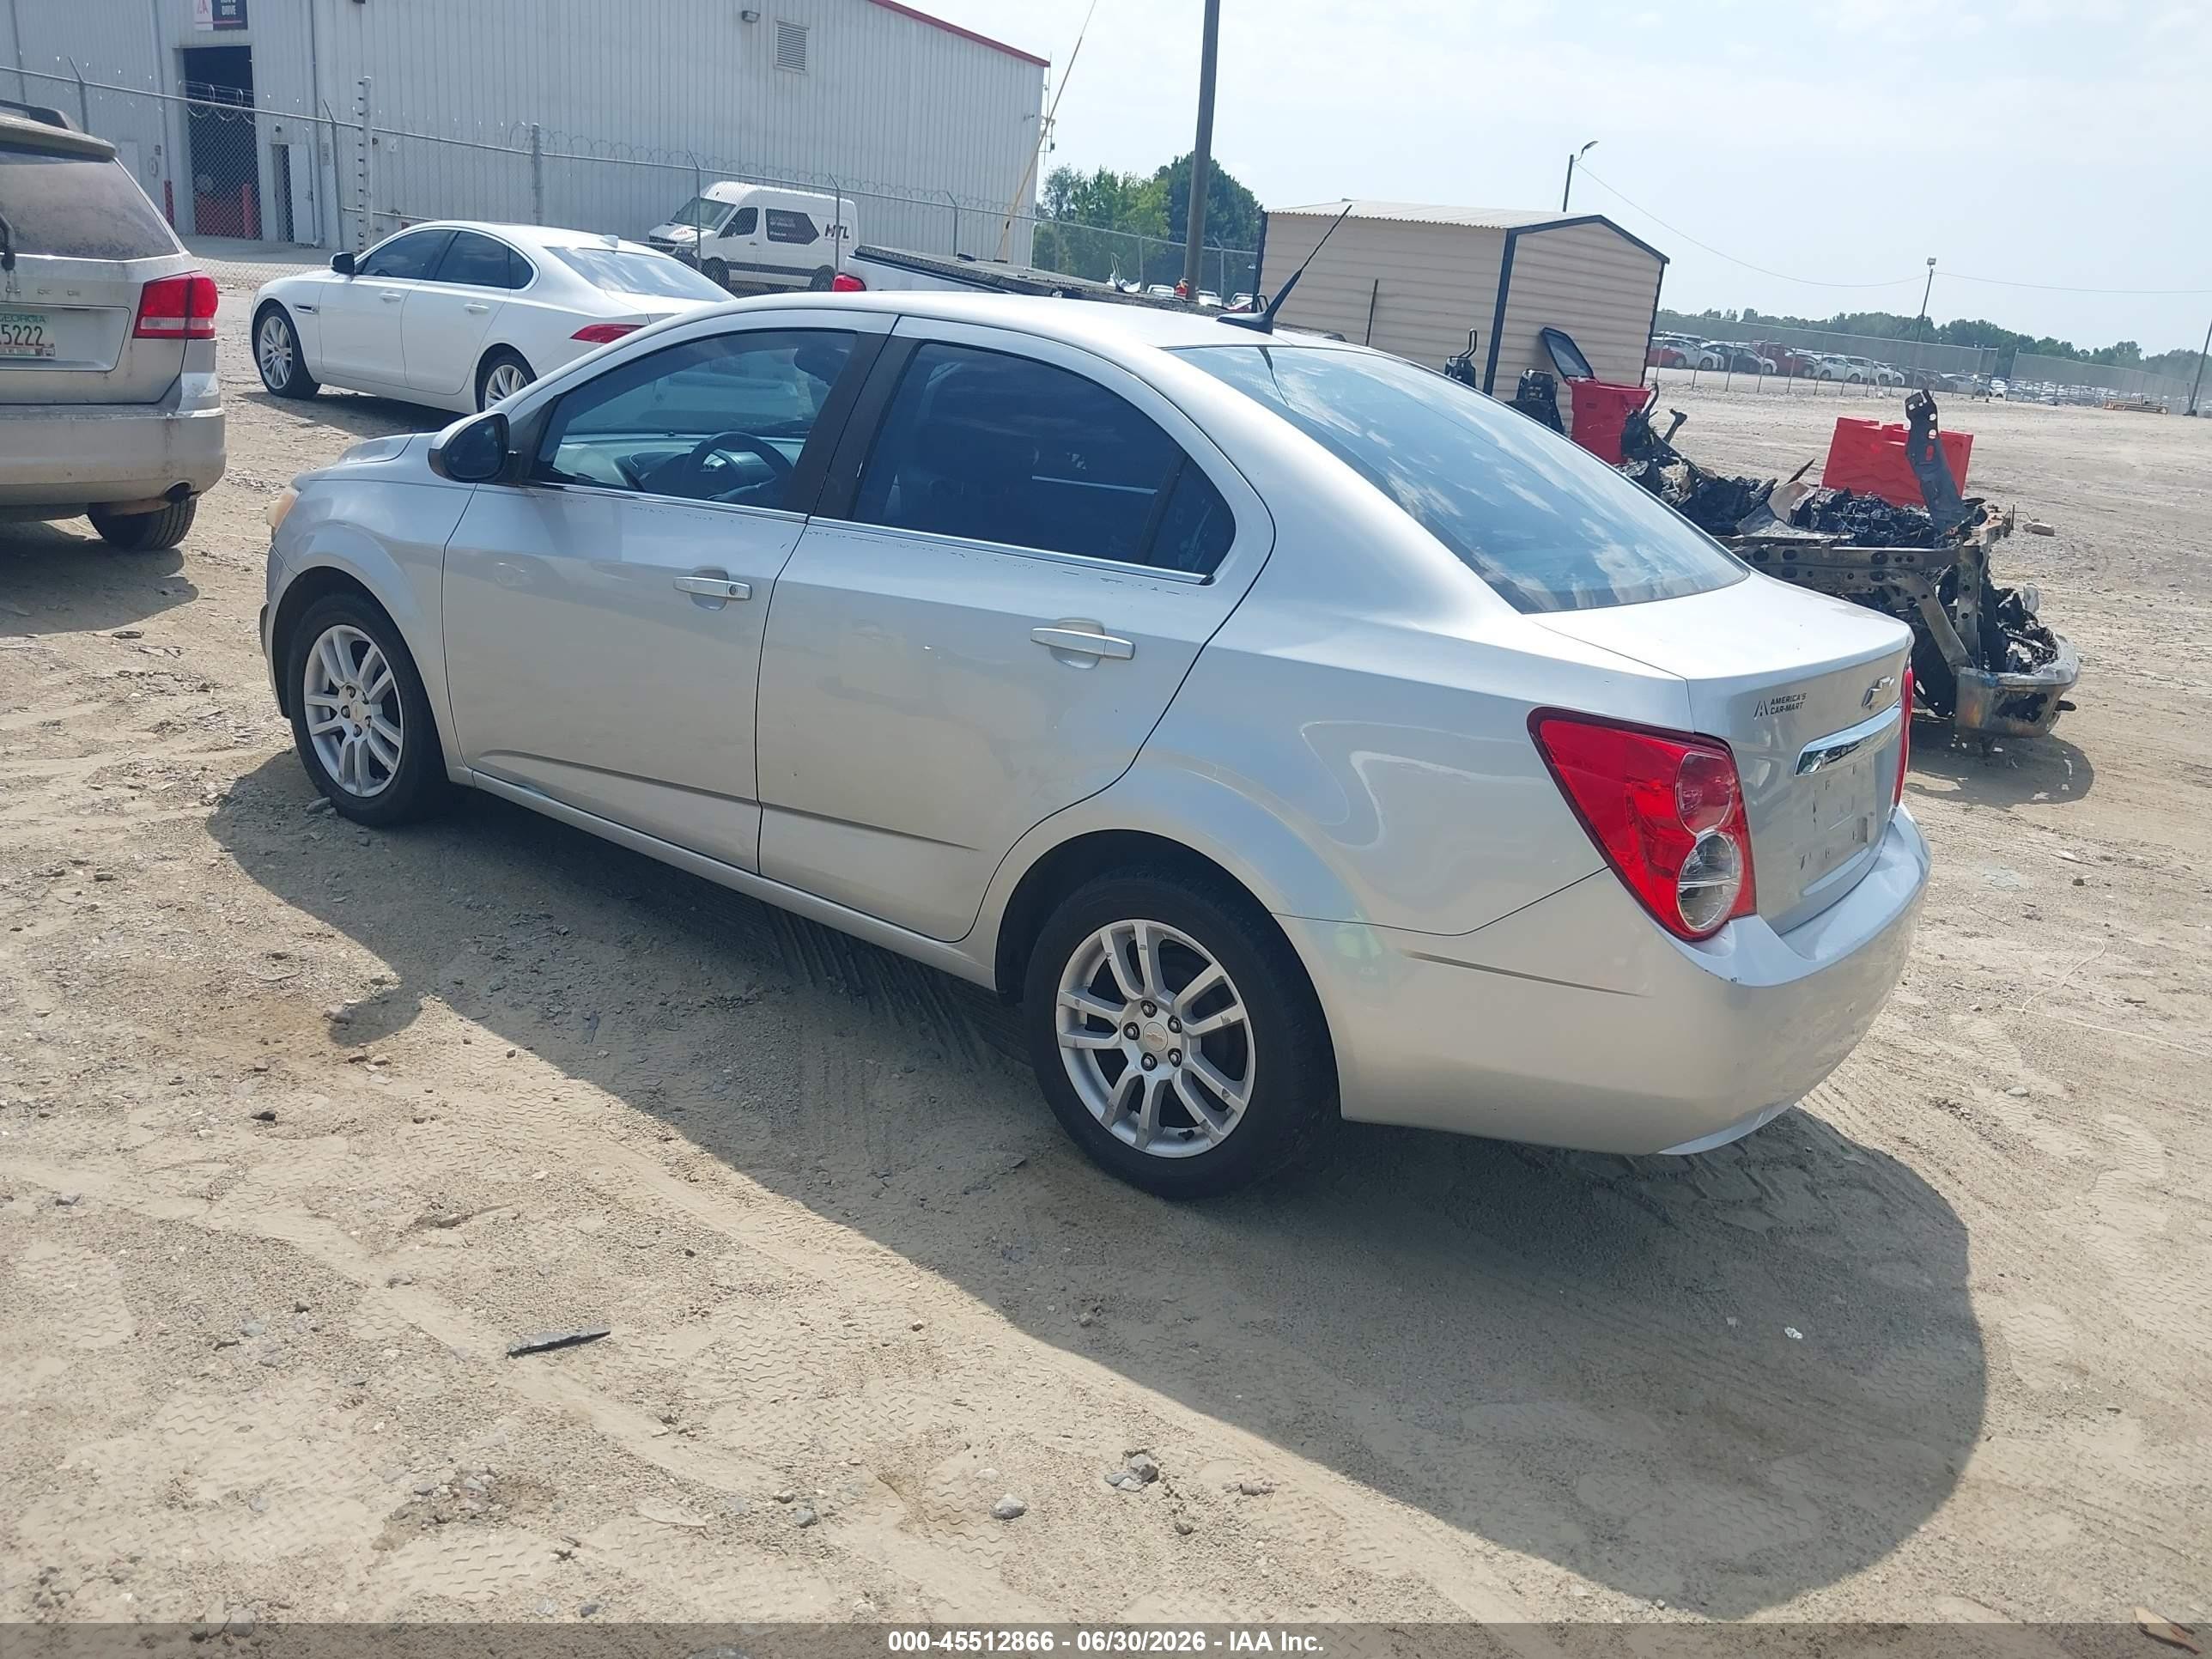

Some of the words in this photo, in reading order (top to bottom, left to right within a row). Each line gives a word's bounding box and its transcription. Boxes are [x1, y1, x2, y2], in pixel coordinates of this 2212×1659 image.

[0, 324, 45, 346] 5222
[1770, 692, 1807, 706] AMERICA'S
[1770, 702, 1804, 715] CAR-MART
